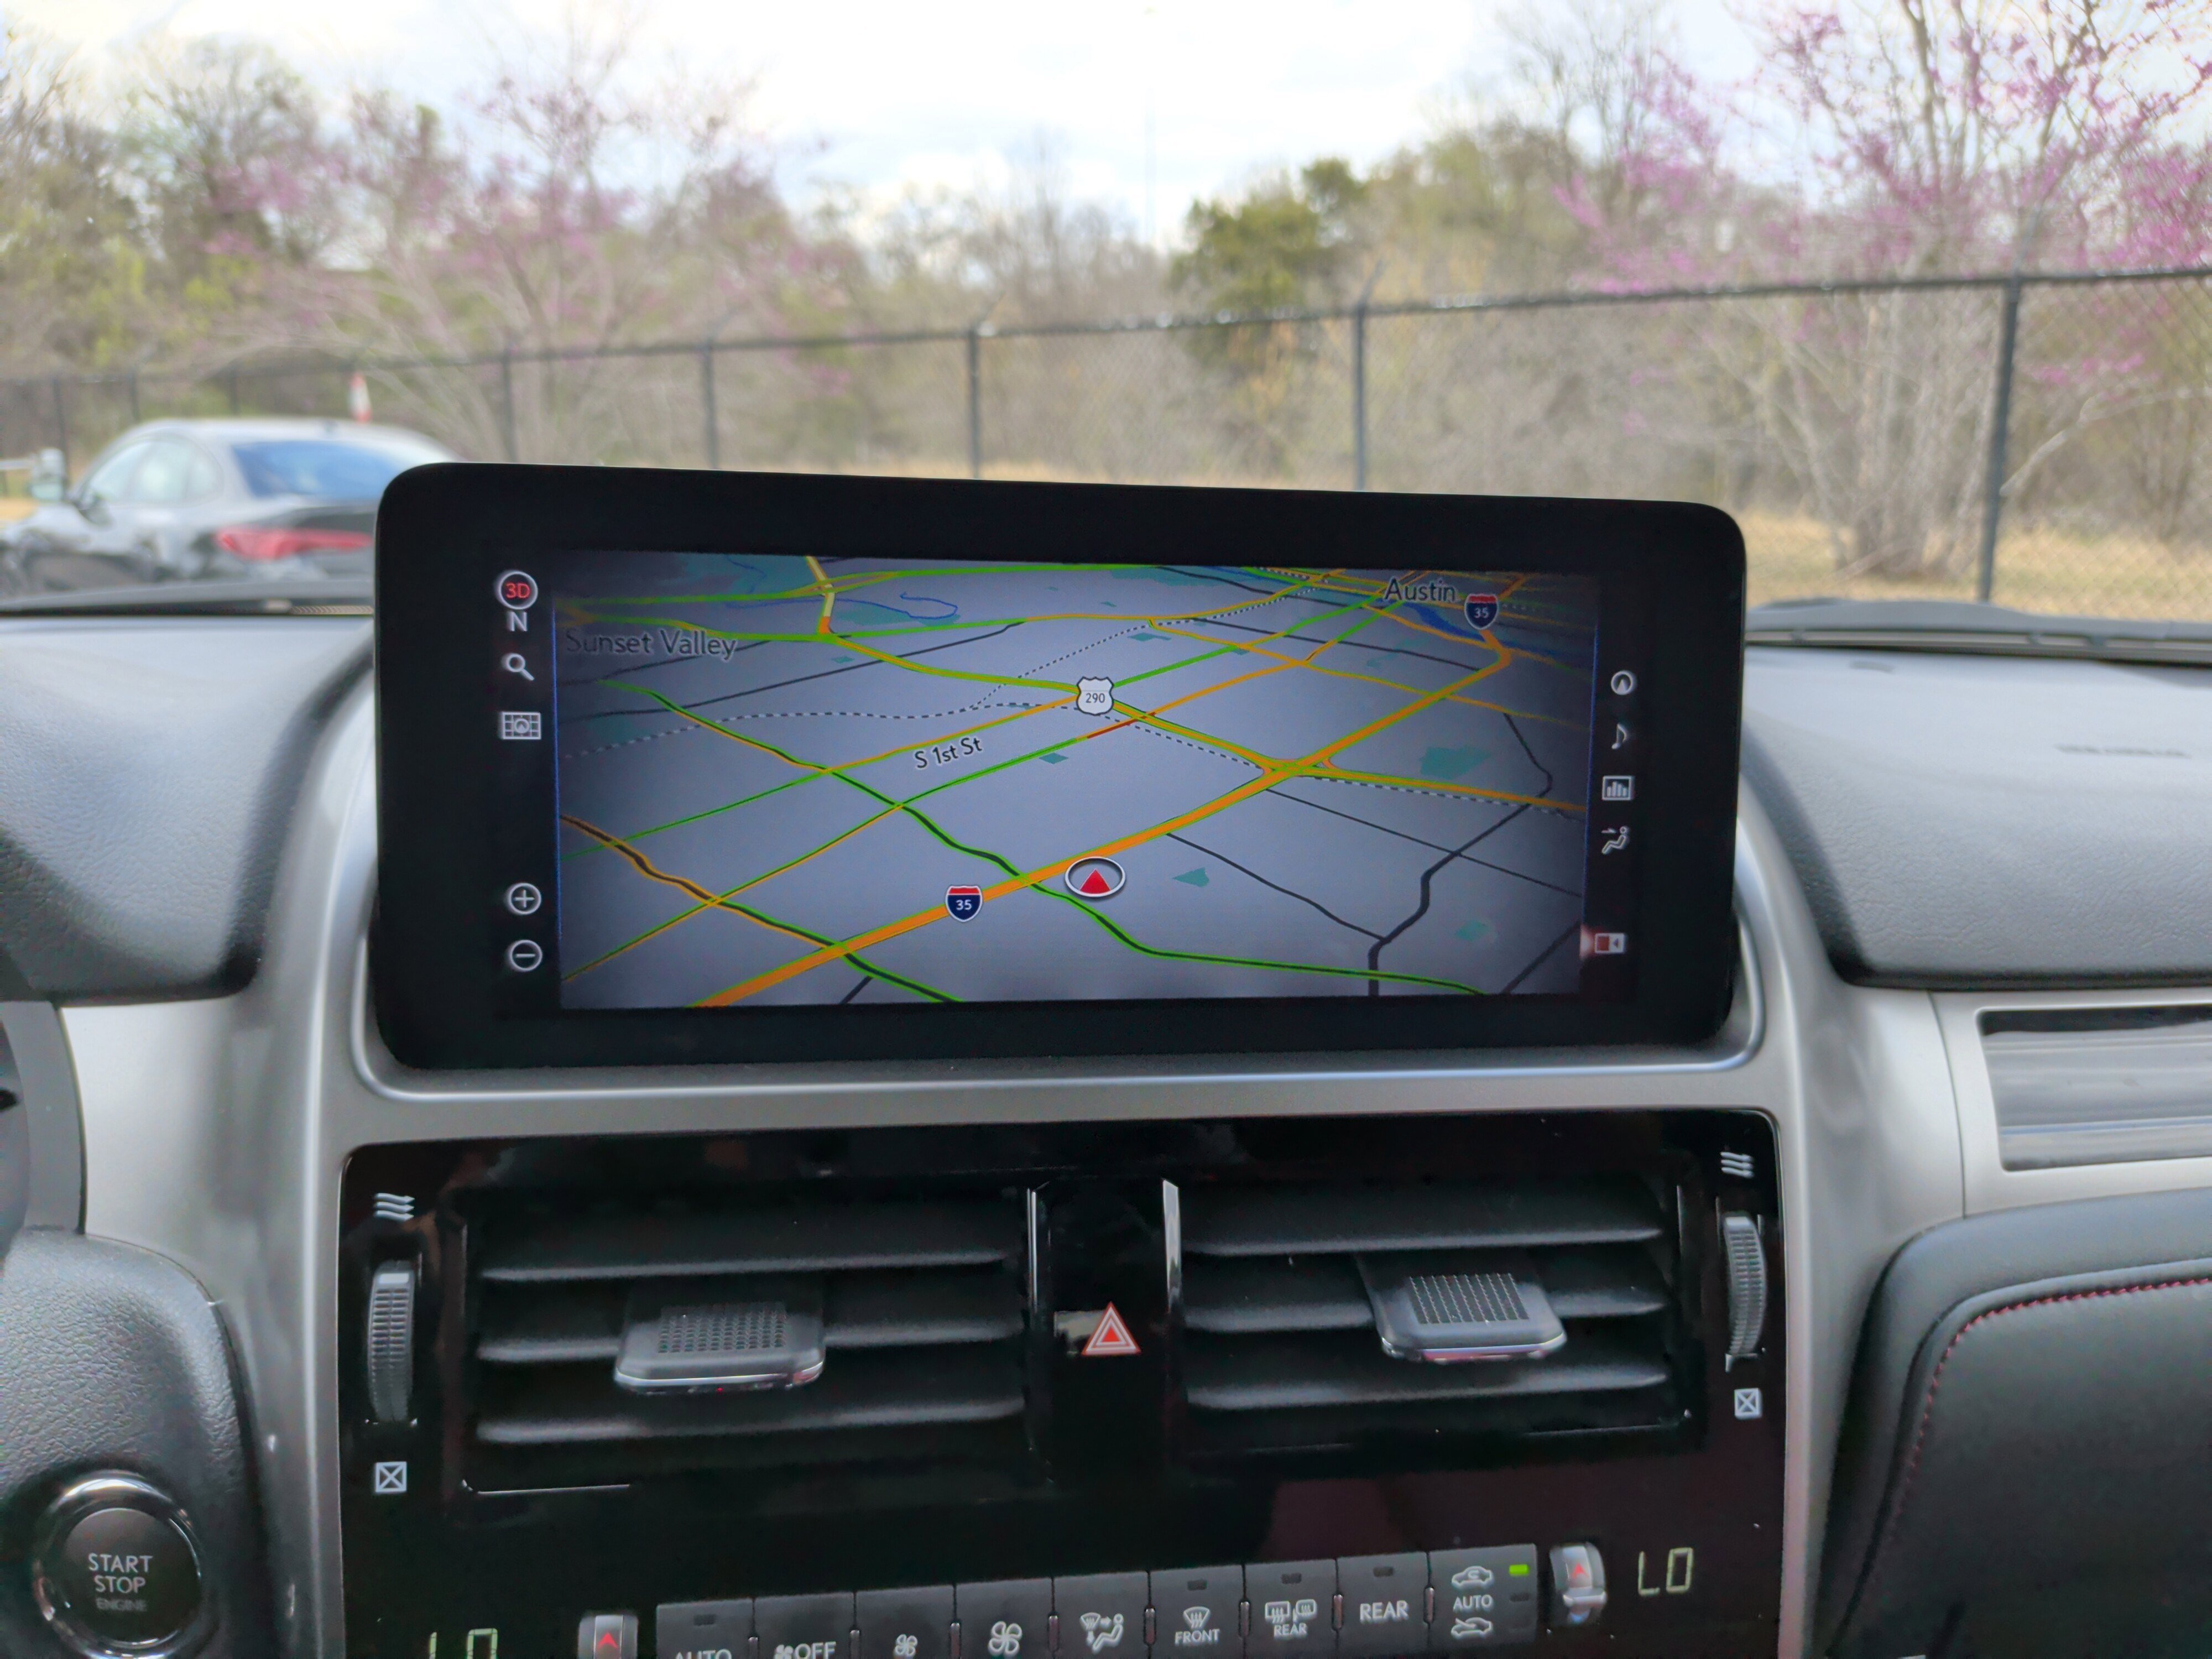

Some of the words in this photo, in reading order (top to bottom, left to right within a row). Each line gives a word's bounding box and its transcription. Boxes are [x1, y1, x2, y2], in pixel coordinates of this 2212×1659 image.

[505, 583, 531, 599] 3D
[1385, 576, 1456, 602] Austin
[507, 611, 528, 632] N
[1474, 607, 1489, 619] 35
[566, 629, 651, 654] Sunset
[660, 629, 737, 660] Valley
[1085, 692, 1105, 704] 290
[914, 750, 928, 769] S
[932, 744, 959, 764] 1st
[960, 737, 983, 755] St
[955, 899, 973, 911] 35
[88, 1552, 153, 1573] START
[94, 1574, 146, 1593] STOP
[96, 1598, 148, 1612] ENGINE
[1453, 1594, 1493, 1611] AUTO
[1359, 1600, 1408, 1623] REAR
[1175, 1629, 1220, 1646] FRONT
[1274, 1623, 1308, 1640] REAR
[794, 1641, 837, 1659] OFF
